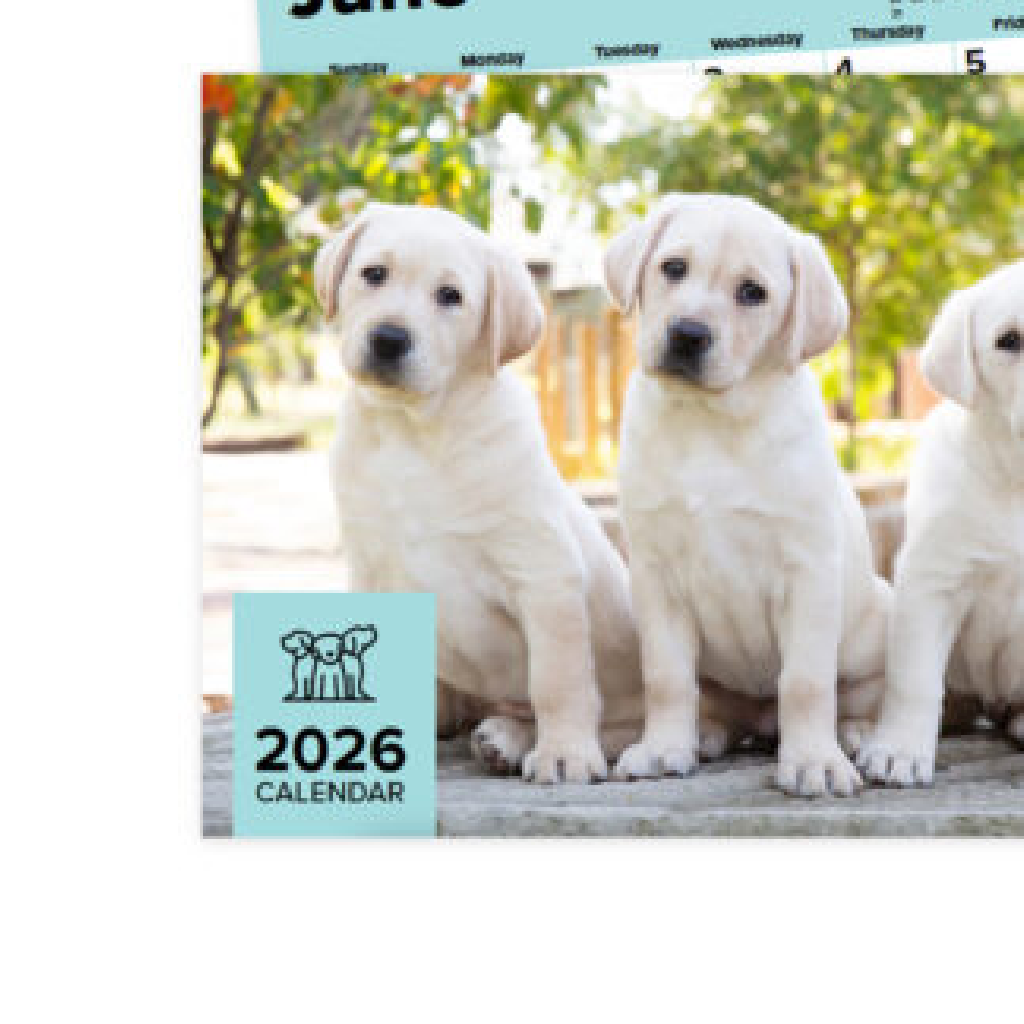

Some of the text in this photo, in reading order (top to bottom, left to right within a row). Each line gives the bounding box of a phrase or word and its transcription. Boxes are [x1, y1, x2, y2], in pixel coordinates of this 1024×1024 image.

[462, 53, 525, 69] Monday
[595, 44, 661, 59] Tuesday
[711, 34, 803, 50] Wednesday
[850, 25, 926, 41] Thursday
[964, 47, 986, 74] 5
[257, 725, 405, 773] 2026
[257, 782, 405, 804] CALENDAR
